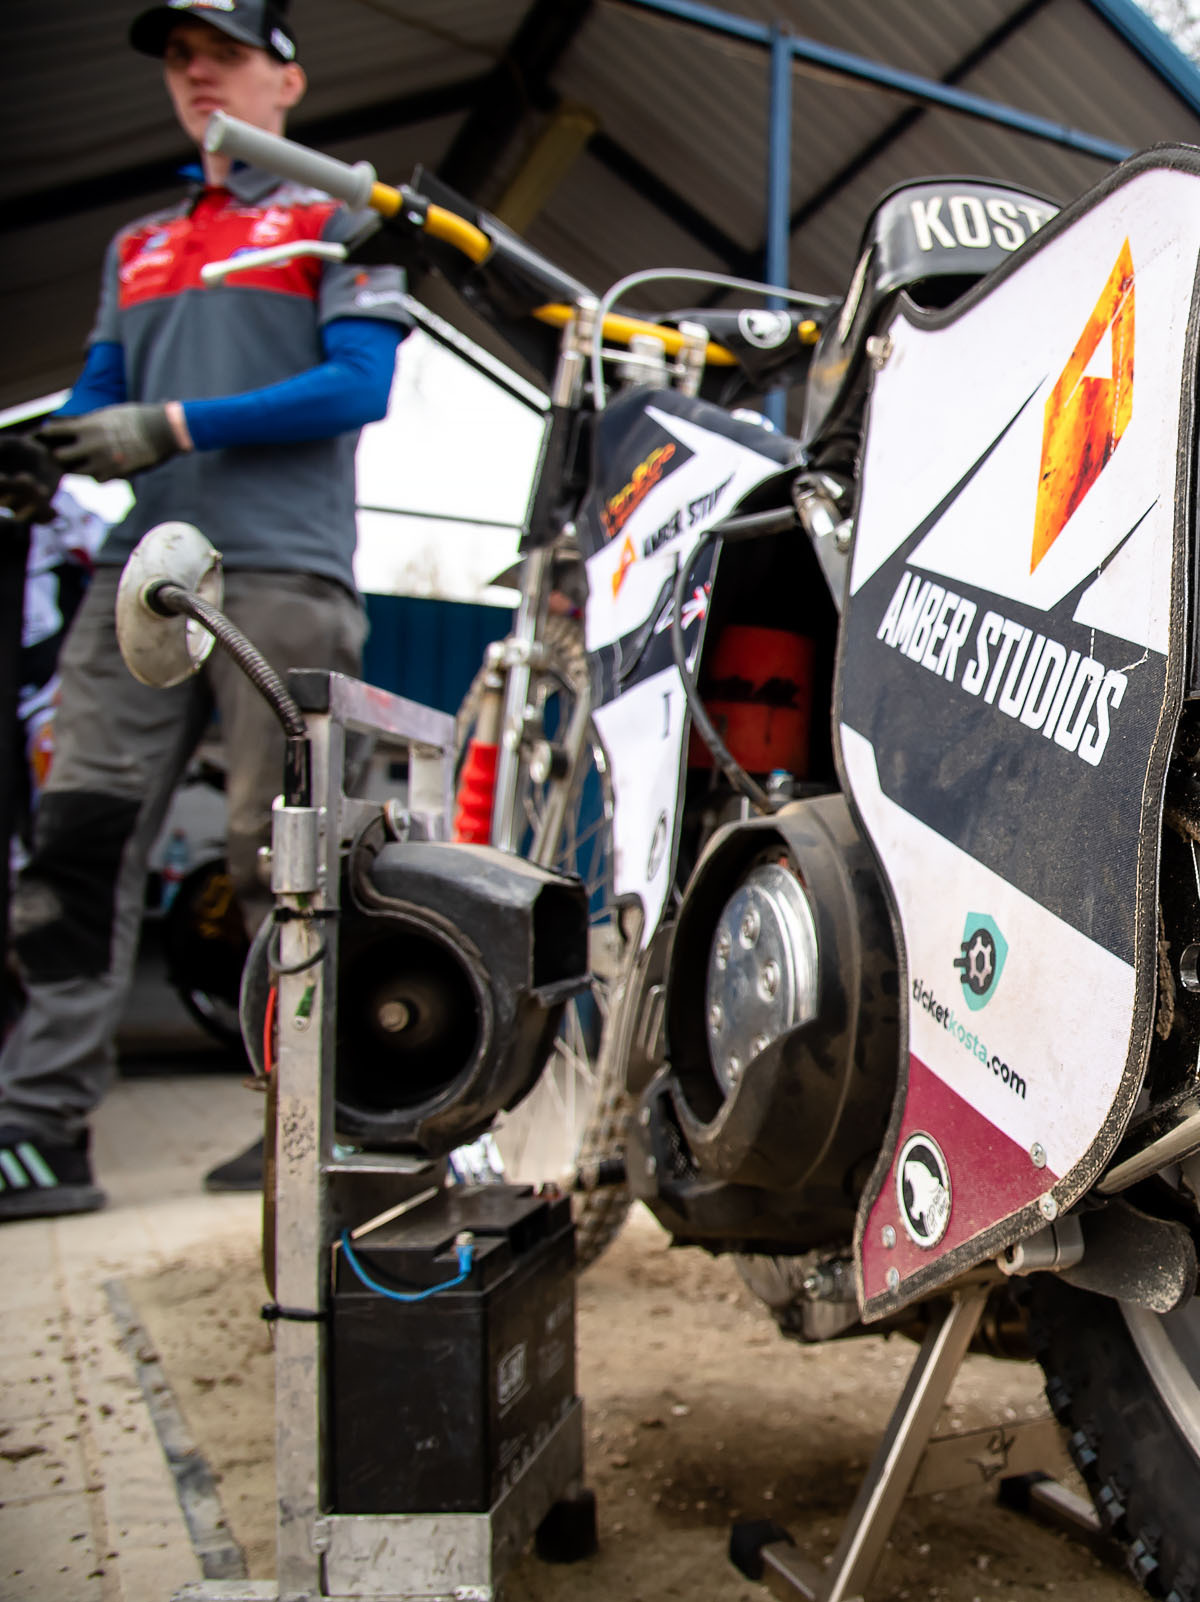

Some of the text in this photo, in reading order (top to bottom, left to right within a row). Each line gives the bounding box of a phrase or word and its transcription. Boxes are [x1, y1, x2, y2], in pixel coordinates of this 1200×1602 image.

[876, 570, 1129, 767] AMBER STUDIOS
[912, 978, 1027, 1100] ticketkosta.com
